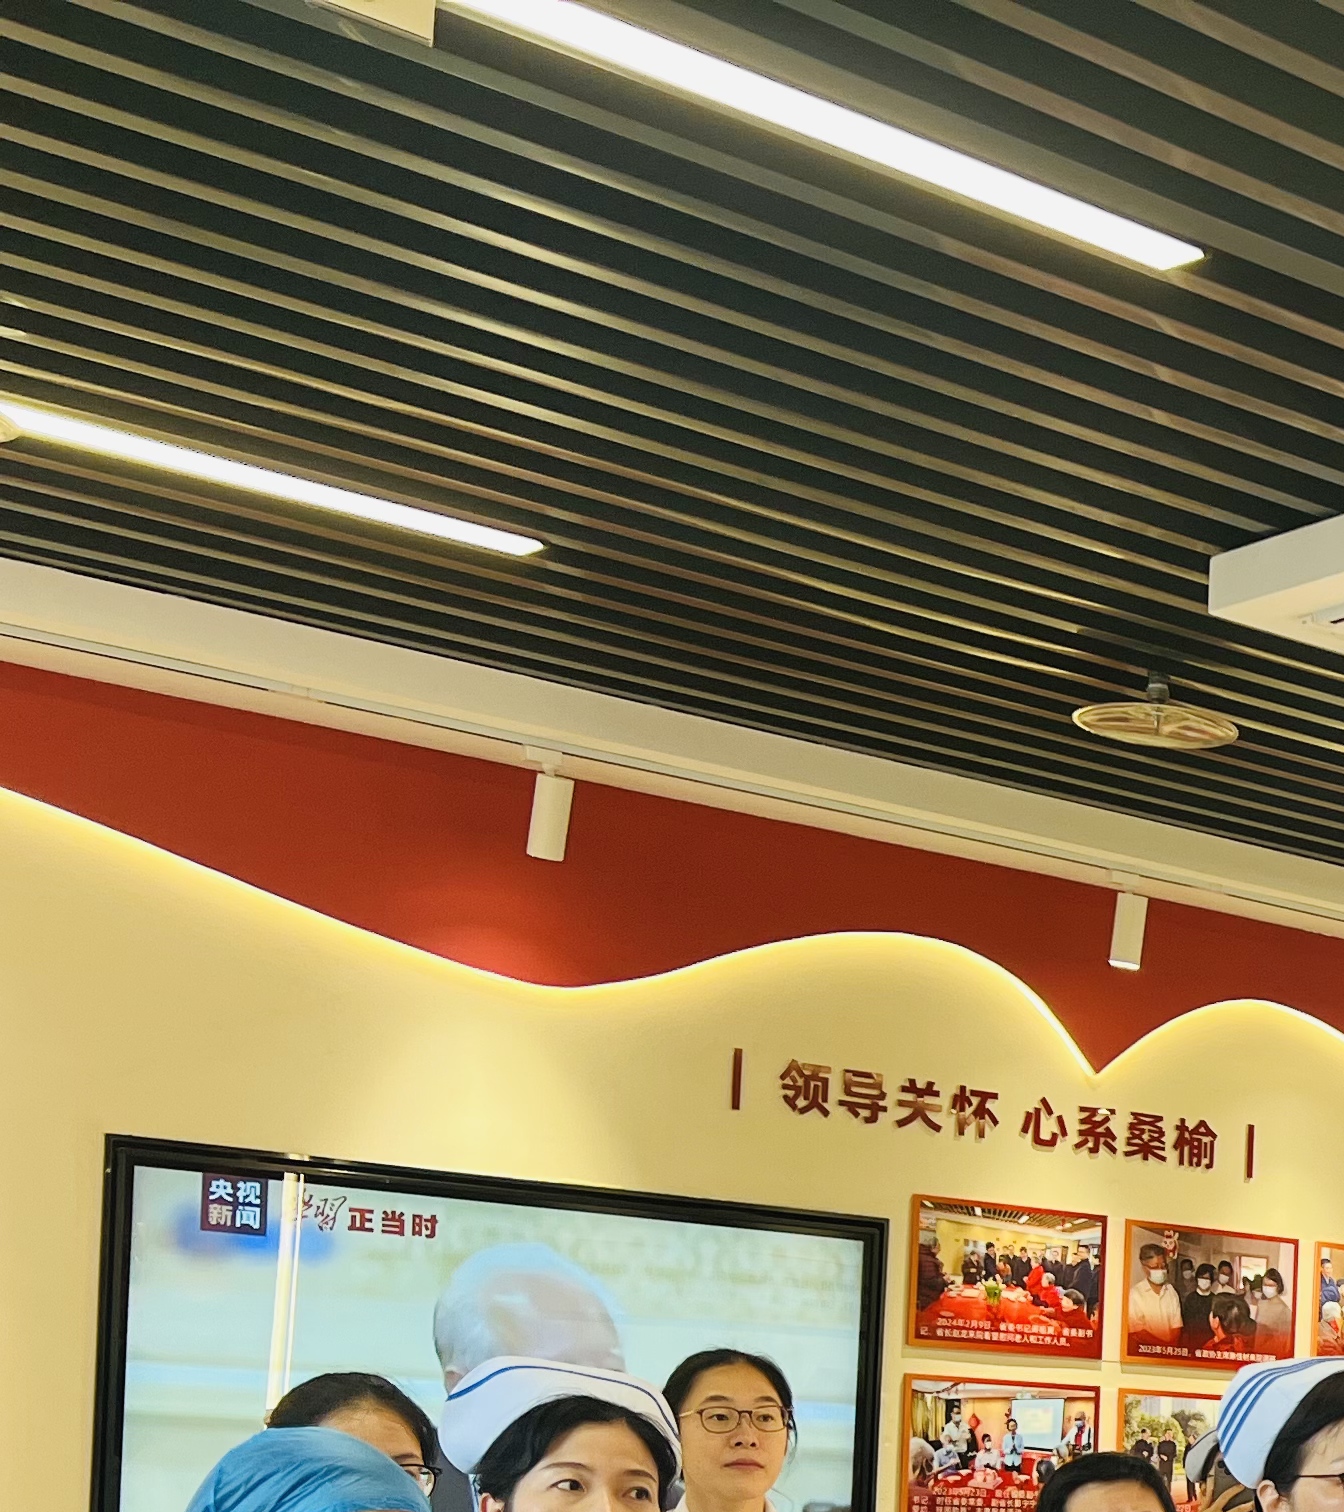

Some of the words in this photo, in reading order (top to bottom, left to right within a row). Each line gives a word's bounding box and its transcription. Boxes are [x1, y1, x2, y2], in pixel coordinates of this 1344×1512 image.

[779, 1058, 999, 1139] 领导关怀
[1021, 1096, 1218, 1170] 心系桑榆
[208, 1178, 261, 1204] 央视
[207, 1204, 261, 1229] 新闻
